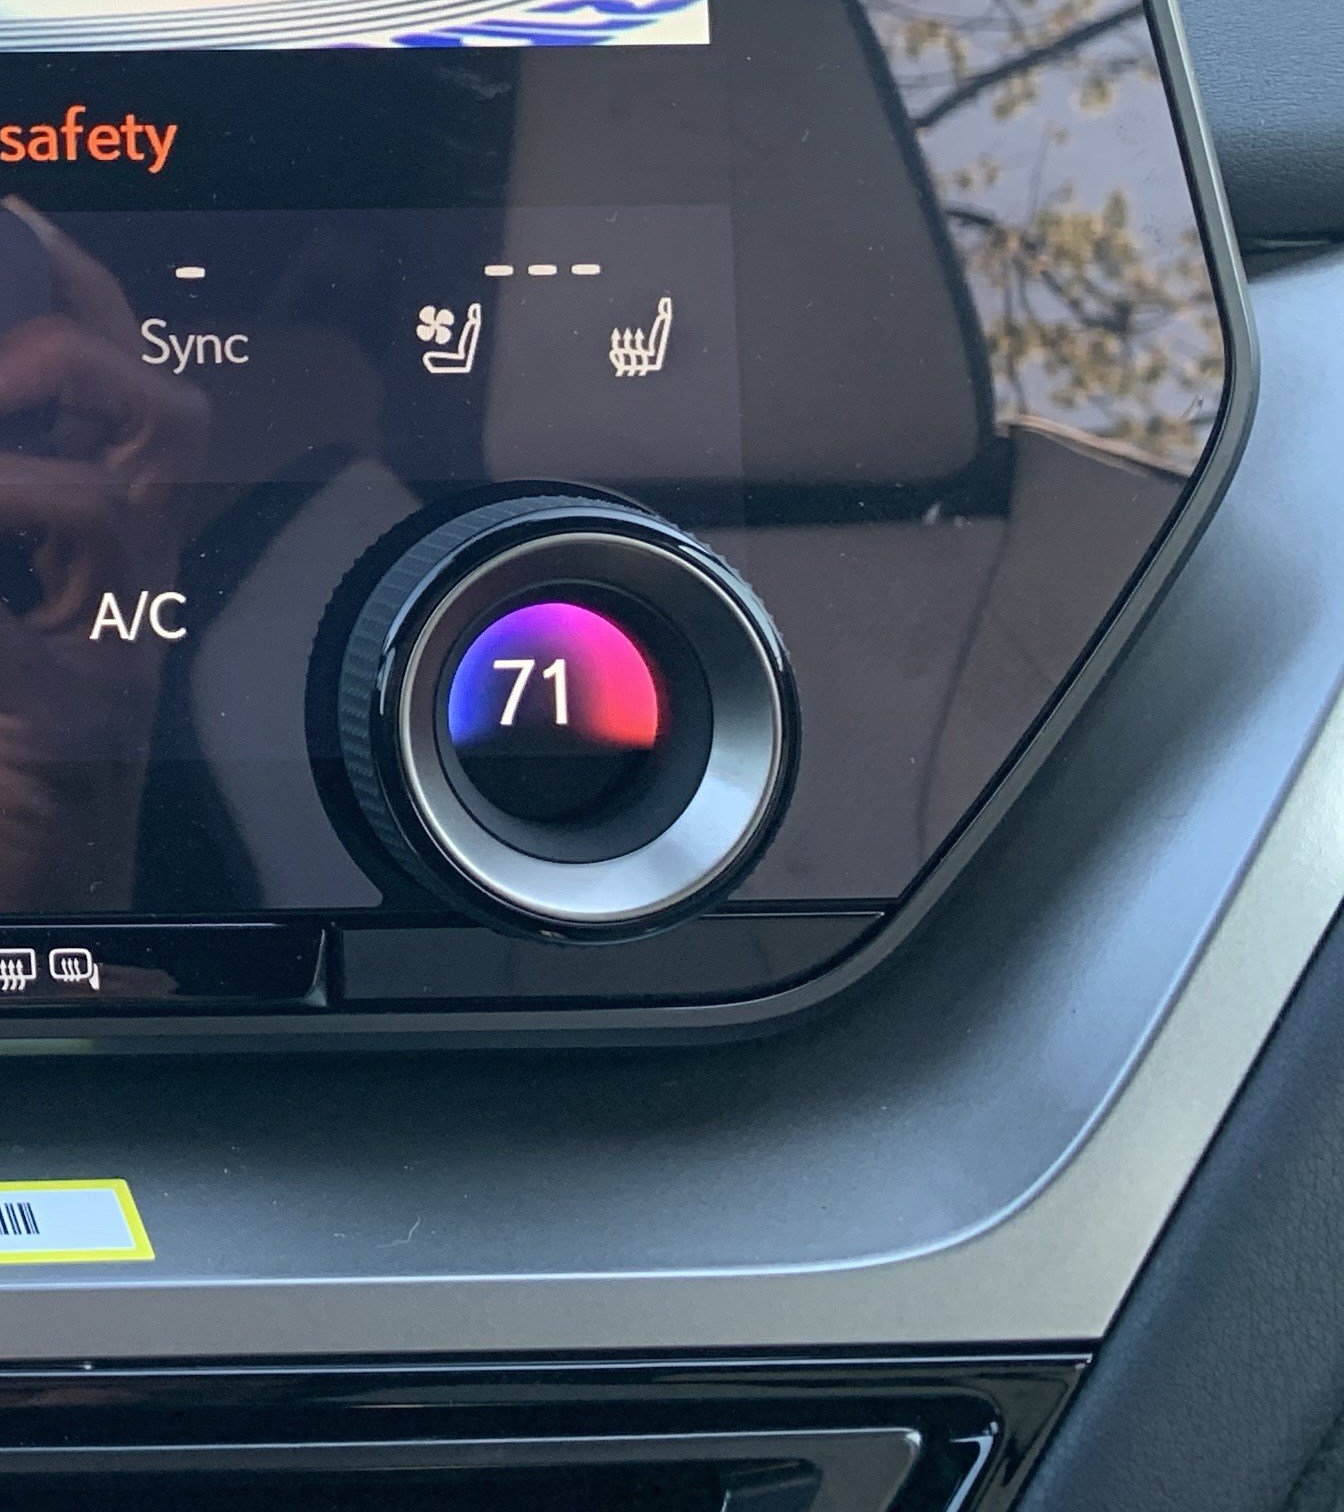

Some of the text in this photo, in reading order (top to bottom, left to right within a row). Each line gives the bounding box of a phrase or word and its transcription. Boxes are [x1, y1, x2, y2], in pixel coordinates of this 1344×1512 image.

[140, 317, 250, 375] Sync
[89, 589, 188, 643] A/C
[492, 656, 570, 727] 71
